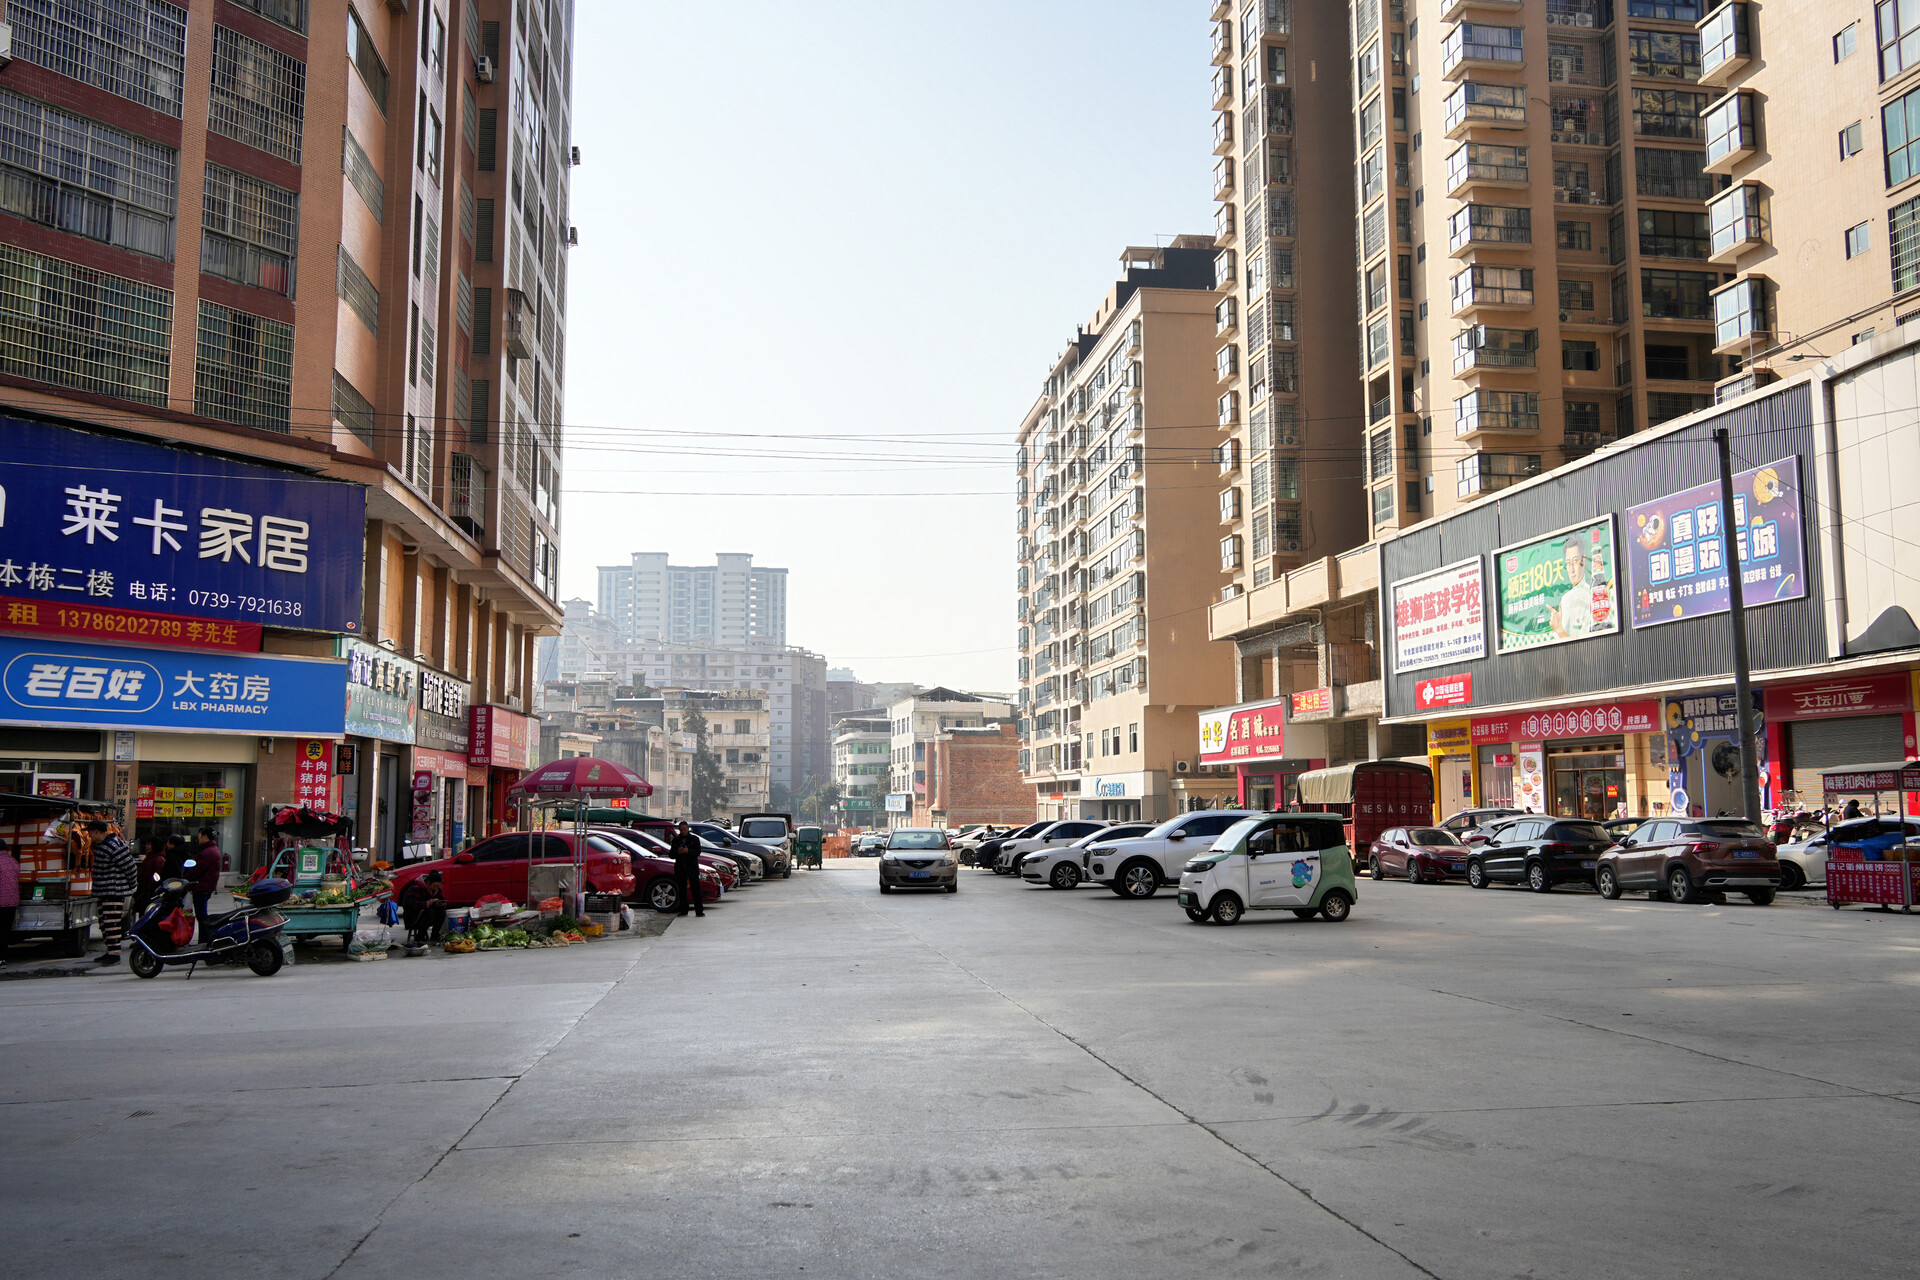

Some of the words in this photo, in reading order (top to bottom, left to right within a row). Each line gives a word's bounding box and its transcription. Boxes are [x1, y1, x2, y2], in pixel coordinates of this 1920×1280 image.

[61, 484, 310, 573] 莱卡家居
[0, 559, 114, 598] 本栋二楼
[189, 589, 302, 616] 0739-7921638
[1396, 579, 1480, 627] 雄狮篮球学校
[7, 602, 39, 626] 租
[58, 609, 182, 637] 13786202789
[187, 621, 238, 645] 李先生
[24, 664, 147, 701] 老百姓
[173, 670, 271, 702] 大药房
[172, 701, 198, 711] LBX
[201, 702, 269, 714] PHARMACY
[1695, 714, 1738, 731] 动漫欢乐
[1202, 721, 1223, 748] 中华
[308, 743, 321, 757] 卖
[301, 760, 327, 771] 牛肉
[300, 772, 327, 784] 猪肉
[1824, 773, 1876, 790] 梅菜扣肉饼
[300, 785, 326, 796] 羊肉
